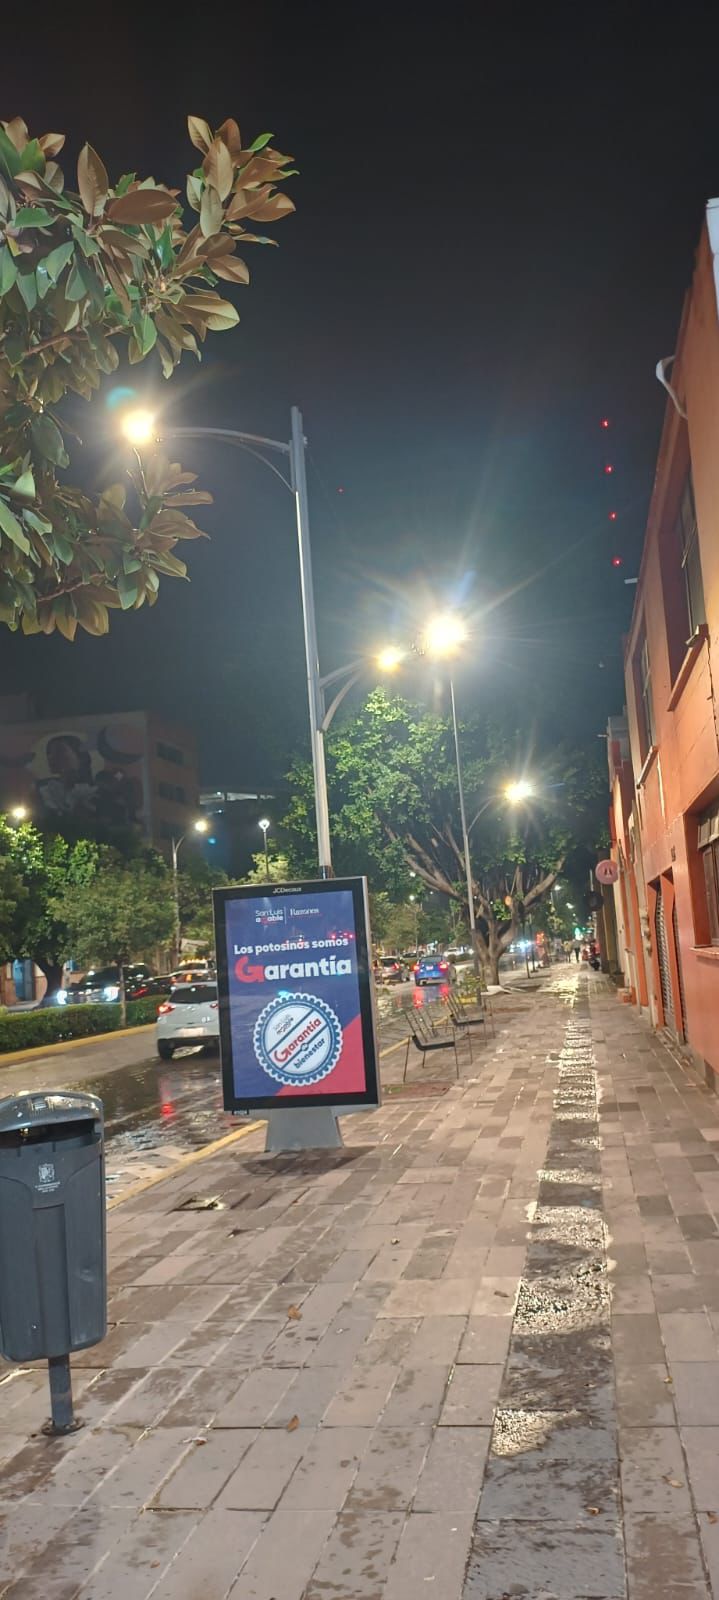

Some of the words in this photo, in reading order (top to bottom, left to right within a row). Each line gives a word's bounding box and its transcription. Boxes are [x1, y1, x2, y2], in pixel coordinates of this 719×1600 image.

[233, 945, 254, 955] Los
[255, 940, 310, 955] potosinos
[312, 938, 349, 949] somos
[235, 955, 352, 983] Garantía
[274, 1018, 322, 1063] Garantía
[293, 1038, 325, 1069] bienestar
